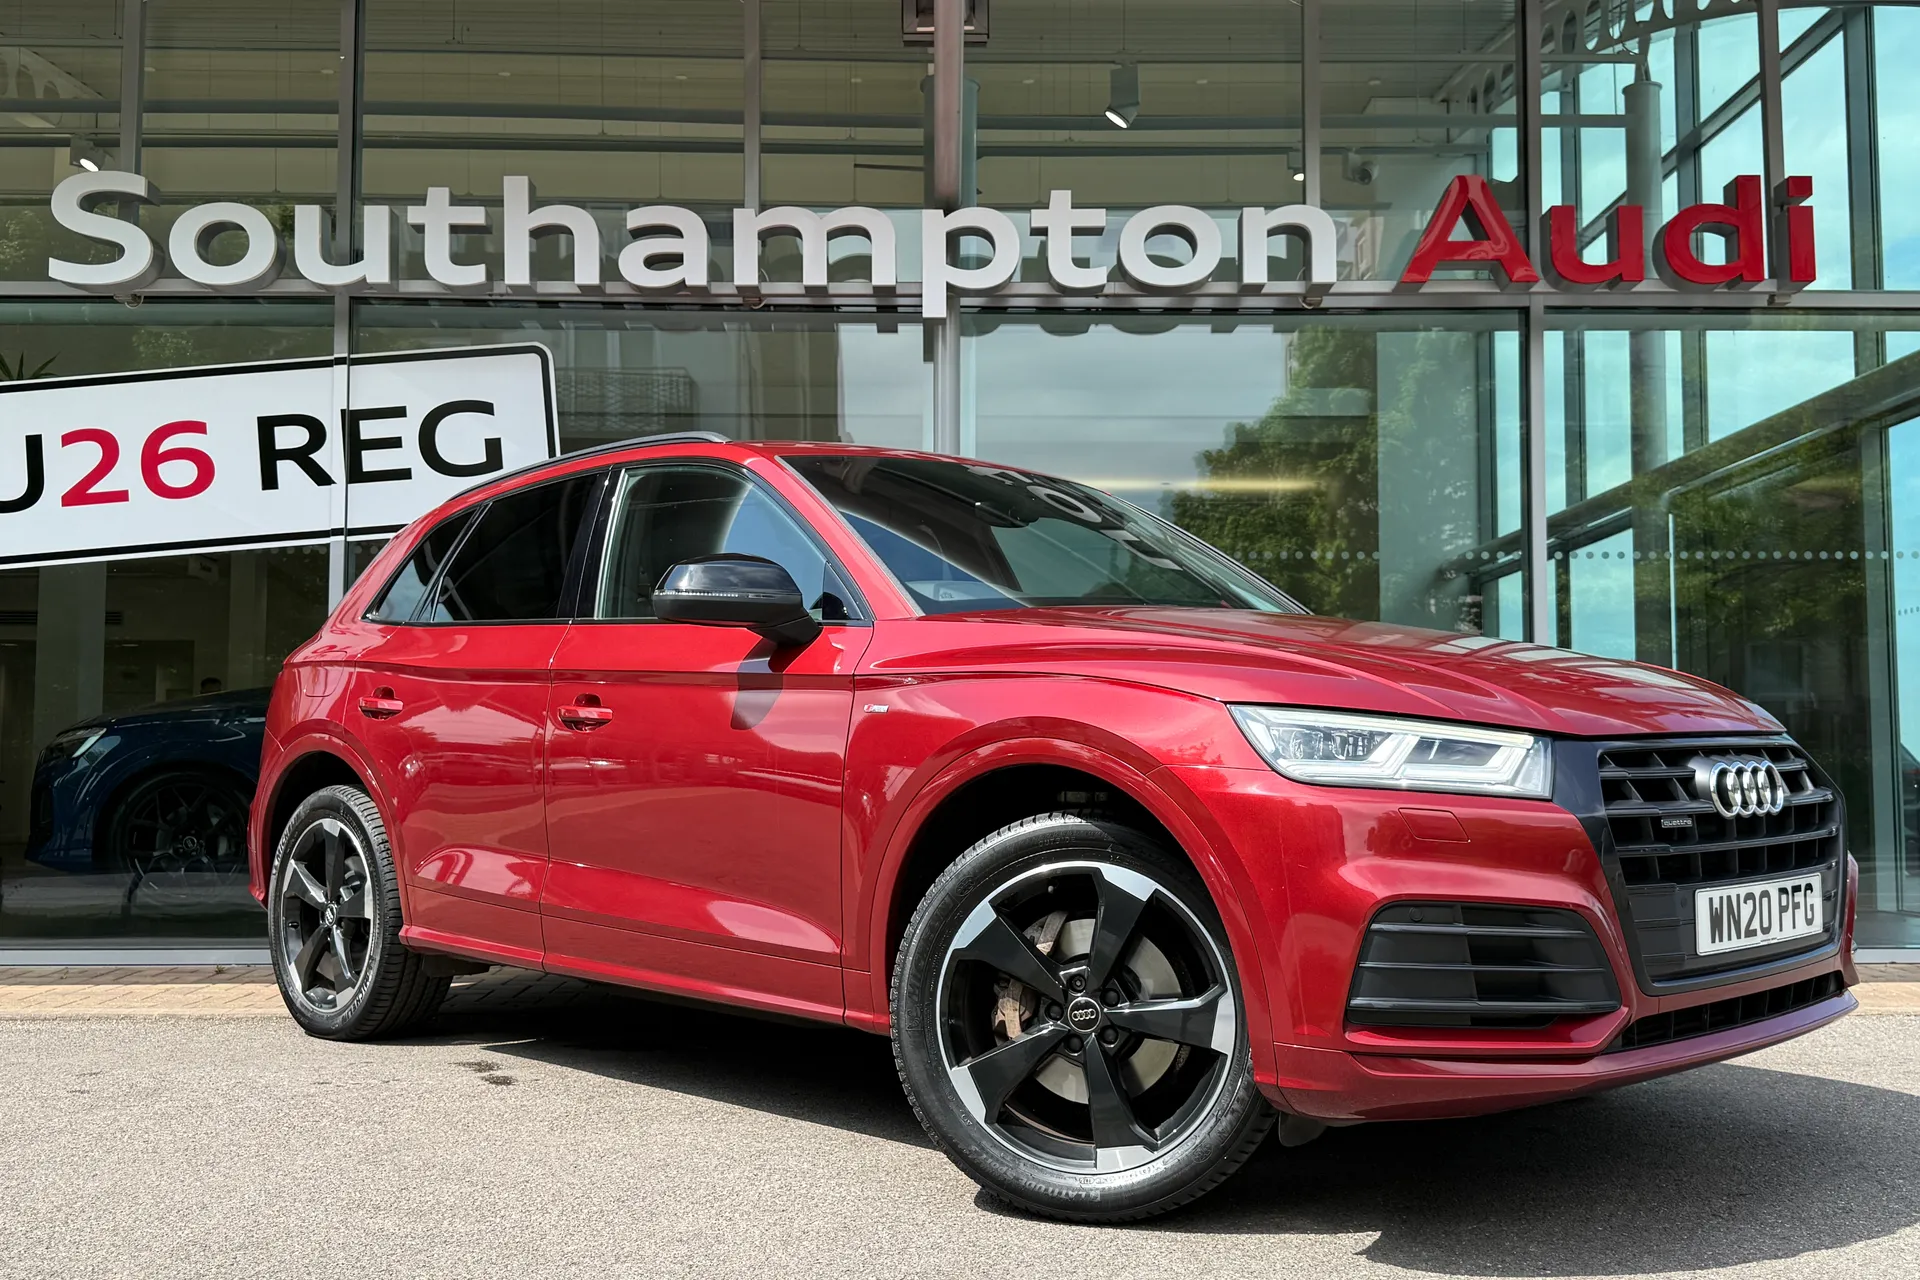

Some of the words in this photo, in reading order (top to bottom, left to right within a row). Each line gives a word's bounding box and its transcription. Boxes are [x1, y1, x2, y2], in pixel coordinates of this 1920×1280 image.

[48, 171, 1338, 318] Southampton
[1399, 174, 1816, 287] Audi
[256, 399, 504, 491] REG
[1663, 818, 1692, 827] quattro
[1708, 889, 1772, 944] WN20
[1777, 882, 1815, 932] PFG
